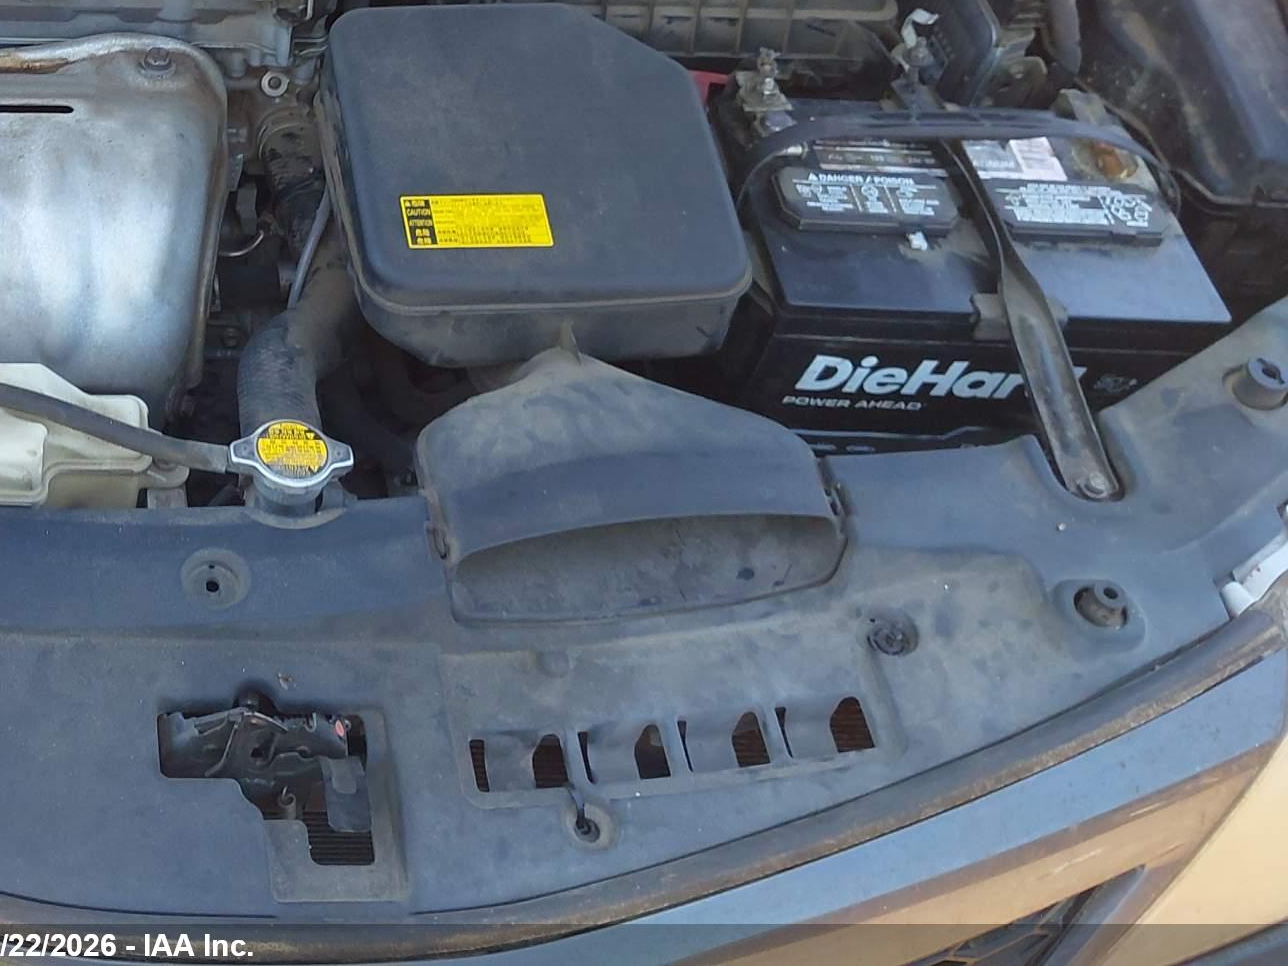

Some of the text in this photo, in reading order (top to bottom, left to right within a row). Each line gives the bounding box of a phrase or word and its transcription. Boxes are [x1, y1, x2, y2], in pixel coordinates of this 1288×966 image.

[818, 172, 864, 184] DANGER
[873, 175, 915, 186] POISON
[406, 208, 431, 217] CAUTION
[794, 353, 1087, 400] DieHar
[781, 394, 923, 411] POWER AHEAD
